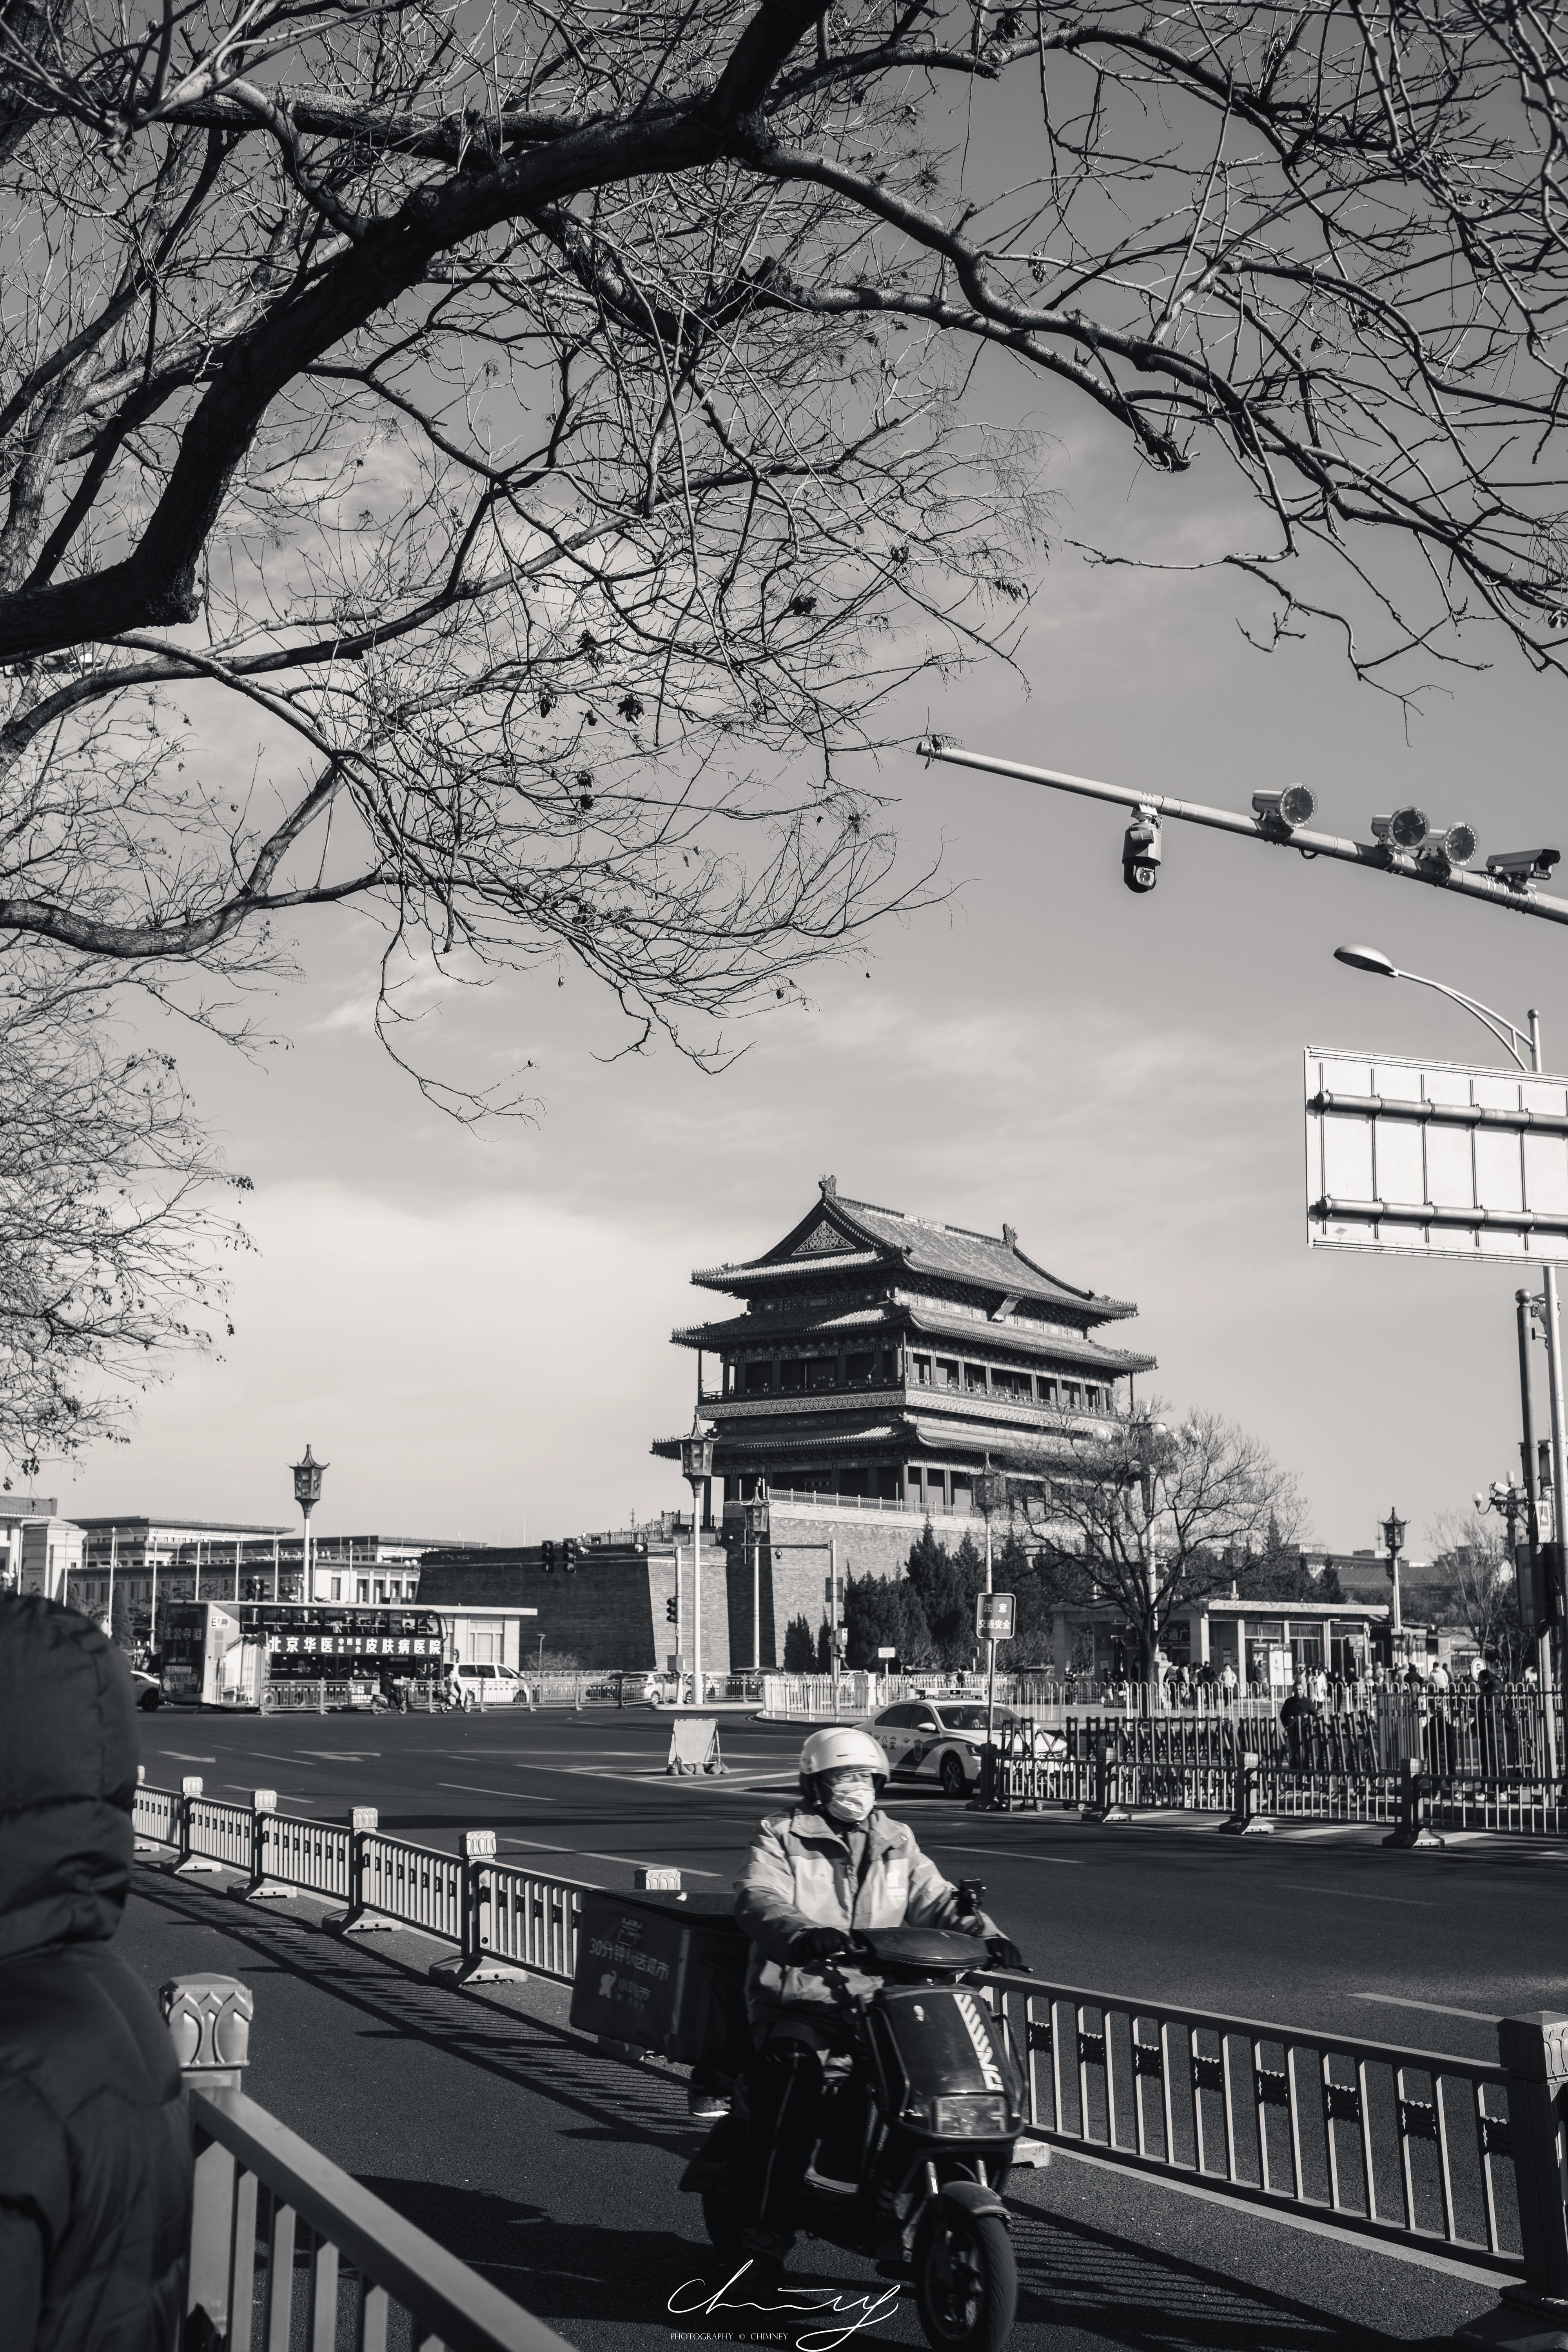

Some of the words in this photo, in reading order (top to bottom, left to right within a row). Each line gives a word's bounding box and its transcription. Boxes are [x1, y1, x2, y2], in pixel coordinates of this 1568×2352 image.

[984, 1603, 1007, 1613] 注意
[978, 1619, 1011, 1629] 交通安全
[269, 1636, 333, 1653] 北京华医
[366, 1638, 441, 1655] 皮肤病医院
[881, 1735, 897, 1750] 公安
